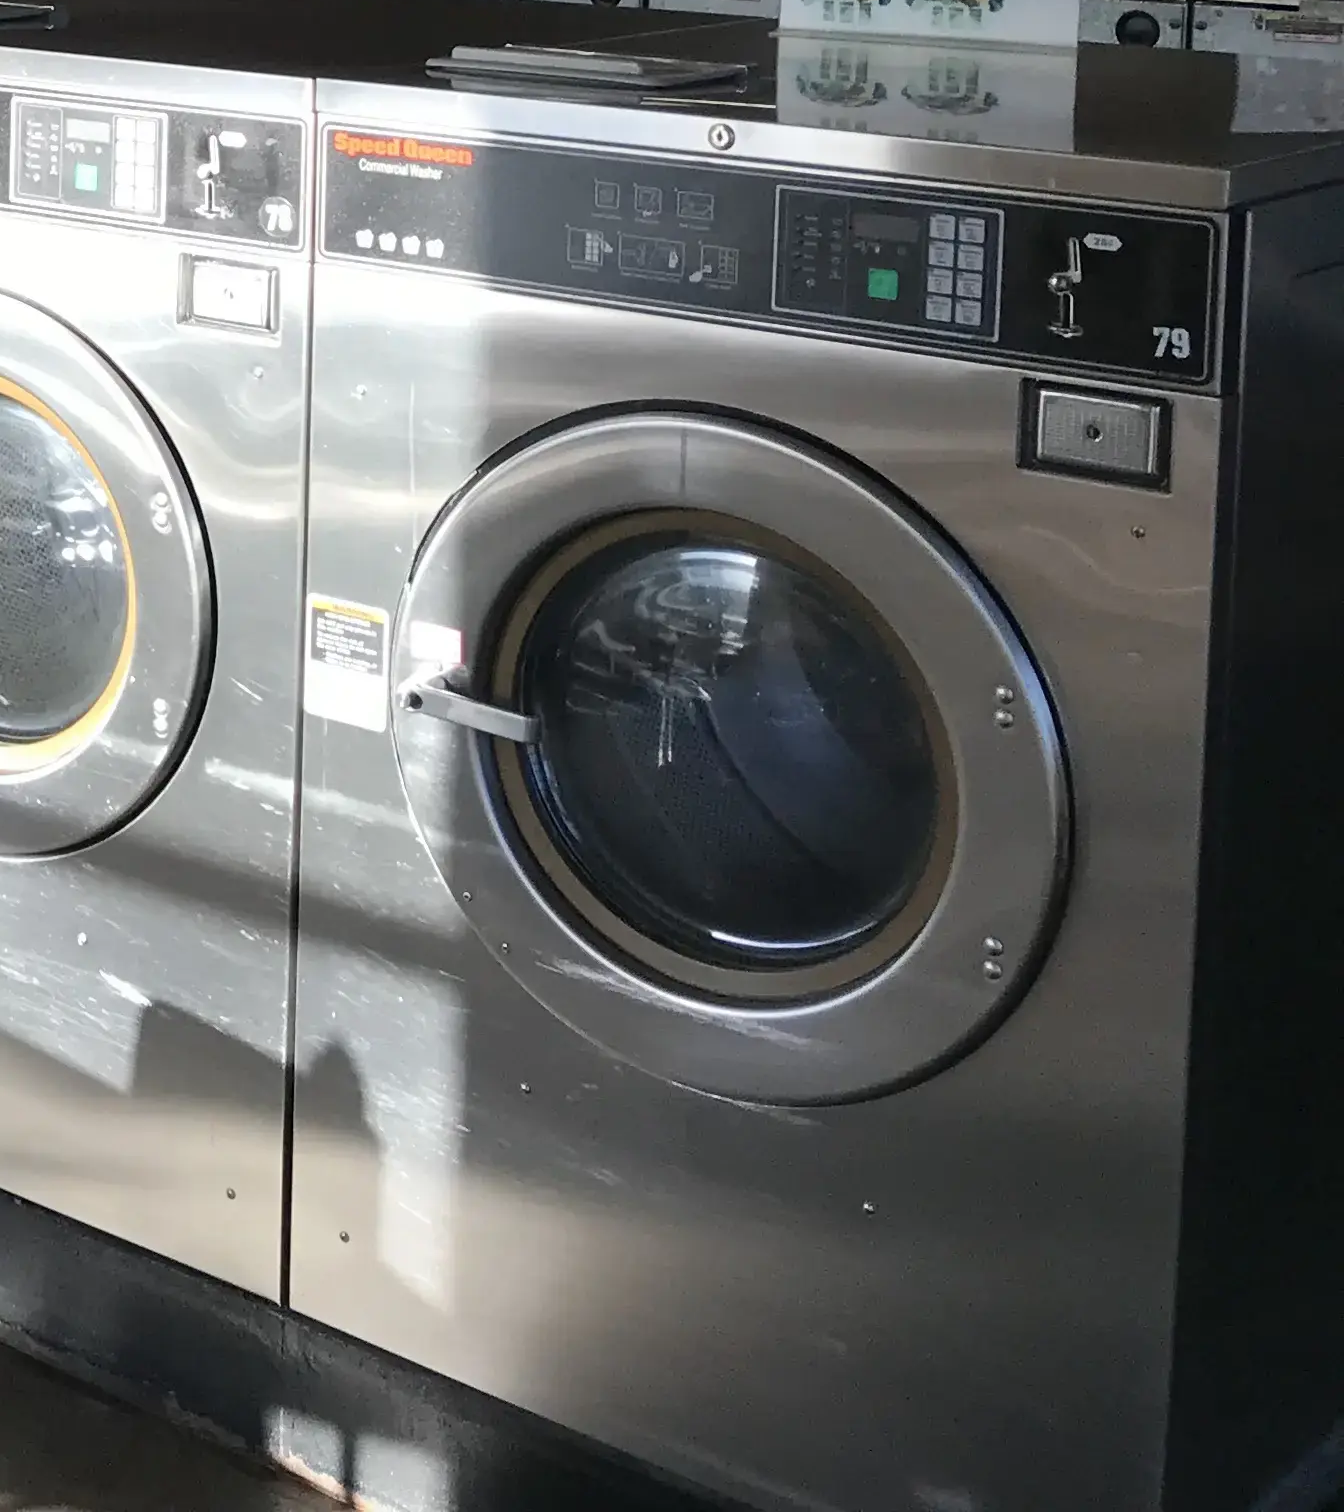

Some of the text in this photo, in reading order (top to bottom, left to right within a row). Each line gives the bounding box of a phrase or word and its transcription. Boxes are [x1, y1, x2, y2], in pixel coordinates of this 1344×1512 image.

[334, 132, 473, 165] Speed Queen
[358, 158, 444, 180] Commercial Washer
[1152, 326, 1191, 359] 79
